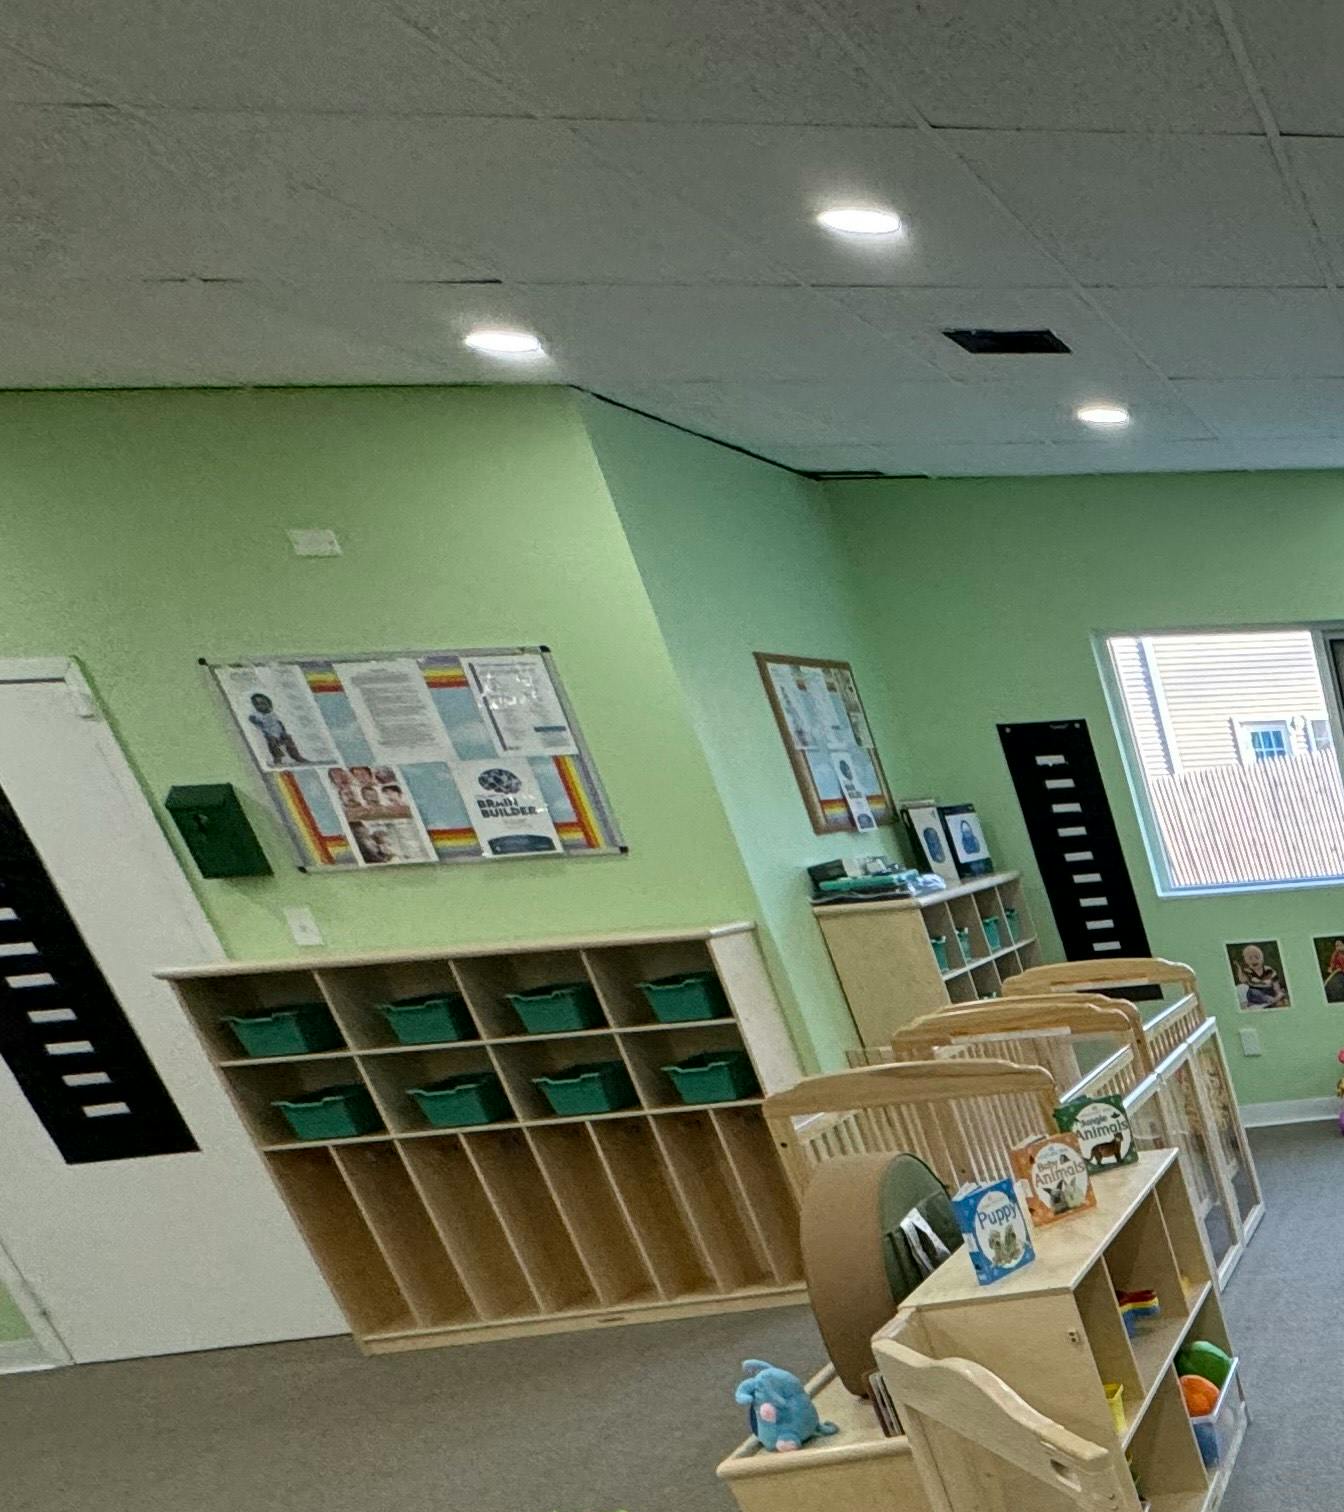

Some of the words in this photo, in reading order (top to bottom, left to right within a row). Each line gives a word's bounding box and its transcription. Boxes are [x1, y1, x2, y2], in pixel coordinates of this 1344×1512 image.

[481, 806, 537, 818] BUILDER
[1075, 1119, 1129, 1141] Animals
[1035, 1160, 1085, 1187] Animals
[976, 1202, 1017, 1230] Puppy
